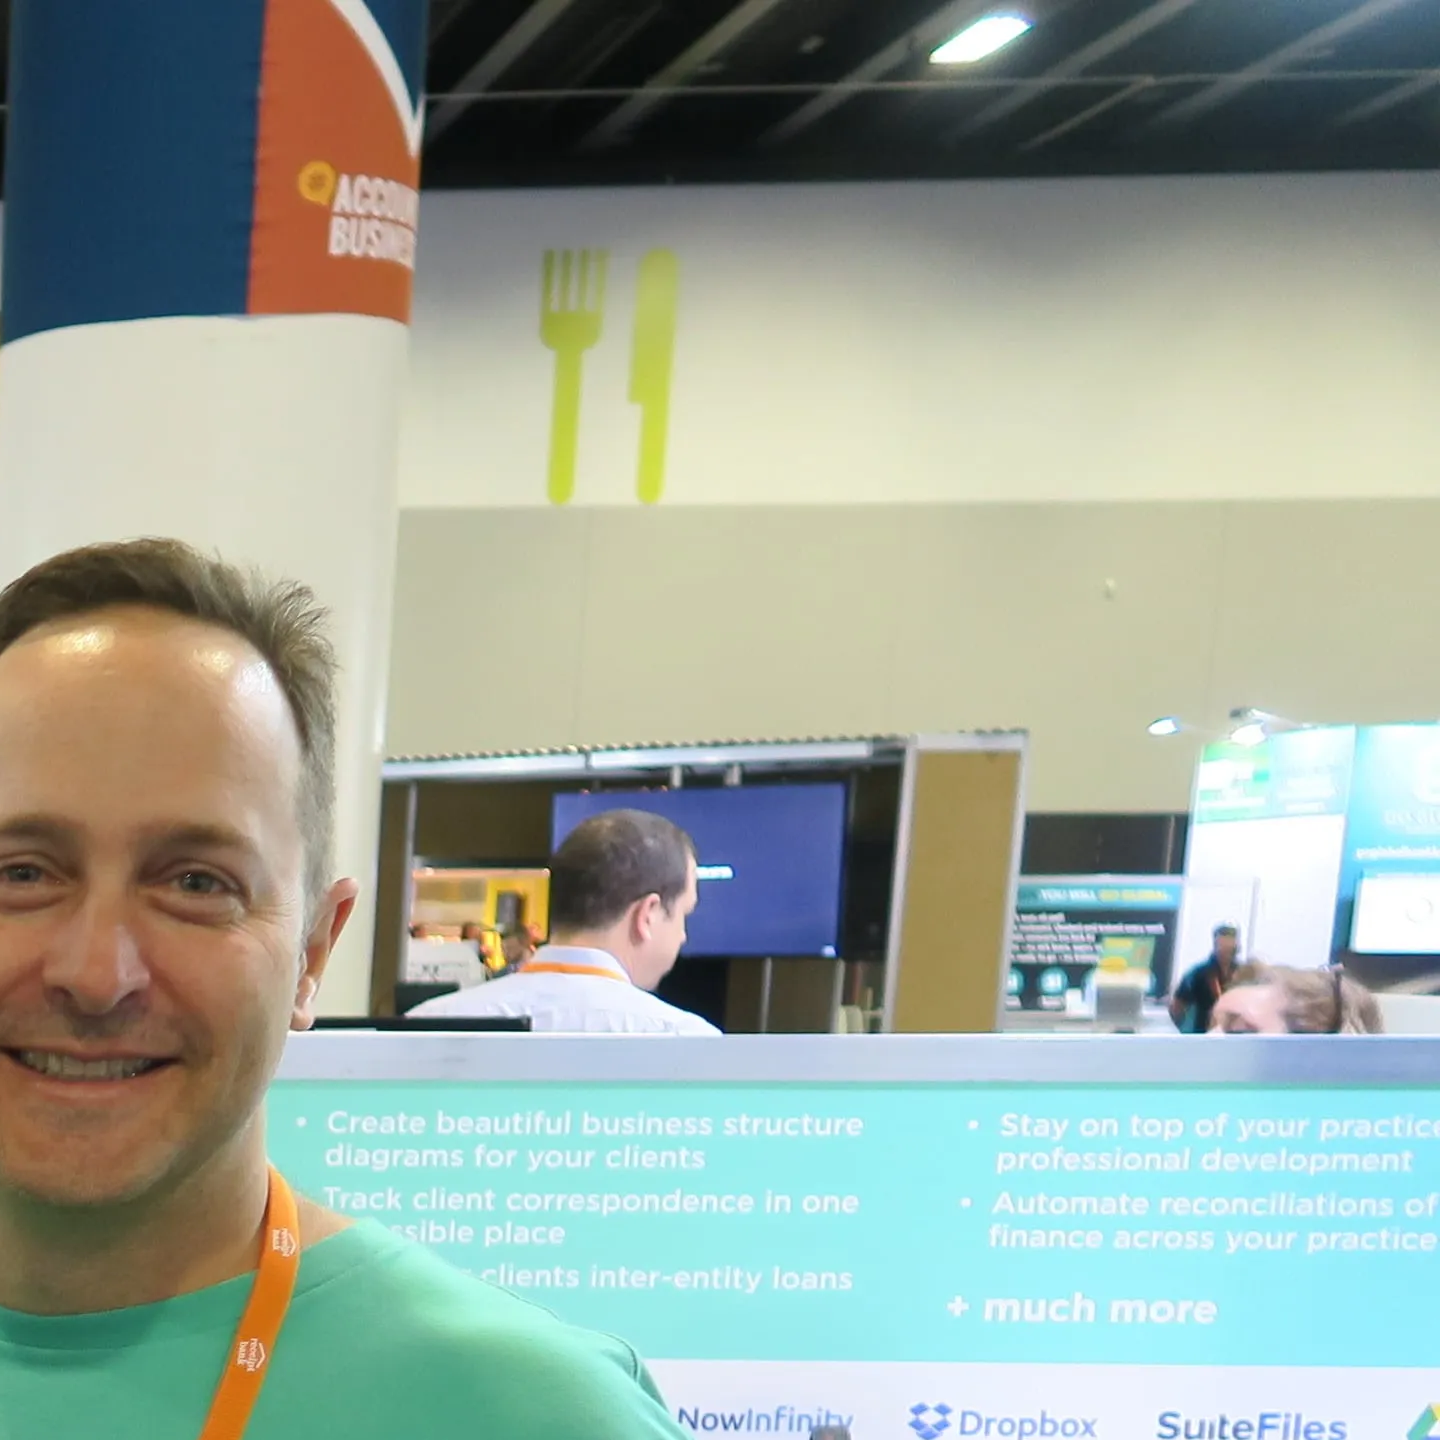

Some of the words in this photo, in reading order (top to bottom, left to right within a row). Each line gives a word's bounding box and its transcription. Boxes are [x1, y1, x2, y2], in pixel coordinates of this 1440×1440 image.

[327, 1110, 426, 1134] Create
[437, 1109, 572, 1135] beautiful
[581, 1109, 713, 1136] business
[723, 1114, 864, 1137] structure
[1000, 1112, 1068, 1142] Stay
[1079, 1119, 1119, 1137] on
[1130, 1116, 1184, 1142] top
[1194, 1112, 1229, 1138] of
[1237, 1119, 1308, 1142] your
[325, 1143, 464, 1172] diagrams
[475, 1144, 517, 1166] for
[527, 1149, 594, 1172] your
[606, 1144, 706, 1170] clients
[996, 1146, 1191, 1175] professional
[1200, 1147, 1413, 1177] development
[323, 1186, 402, 1210] Track
[413, 1187, 496, 1211] client
[506, 1189, 754, 1216] correspondence
[765, 1190, 792, 1213] in
[802, 1193, 860, 1214] one
[991, 1192, 1150, 1216] Automate
[1160, 1192, 1394, 1218] reconciliations
[1404, 1192, 1439, 1218] of
[484, 1220, 565, 1248] place
[989, 1224, 1103, 1250] finance
[1113, 1230, 1215, 1250] across
[1226, 1230, 1298, 1254] your
[1306, 1225, 1437, 1254] practice
[481, 1264, 579, 1288] clients
[590, 1265, 761, 1294] inter-entity
[772, 1266, 854, 1290] loans
[947, 1295, 969, 1317] +
[983, 1291, 1096, 1324] much
[1110, 1298, 1218, 1324] more
